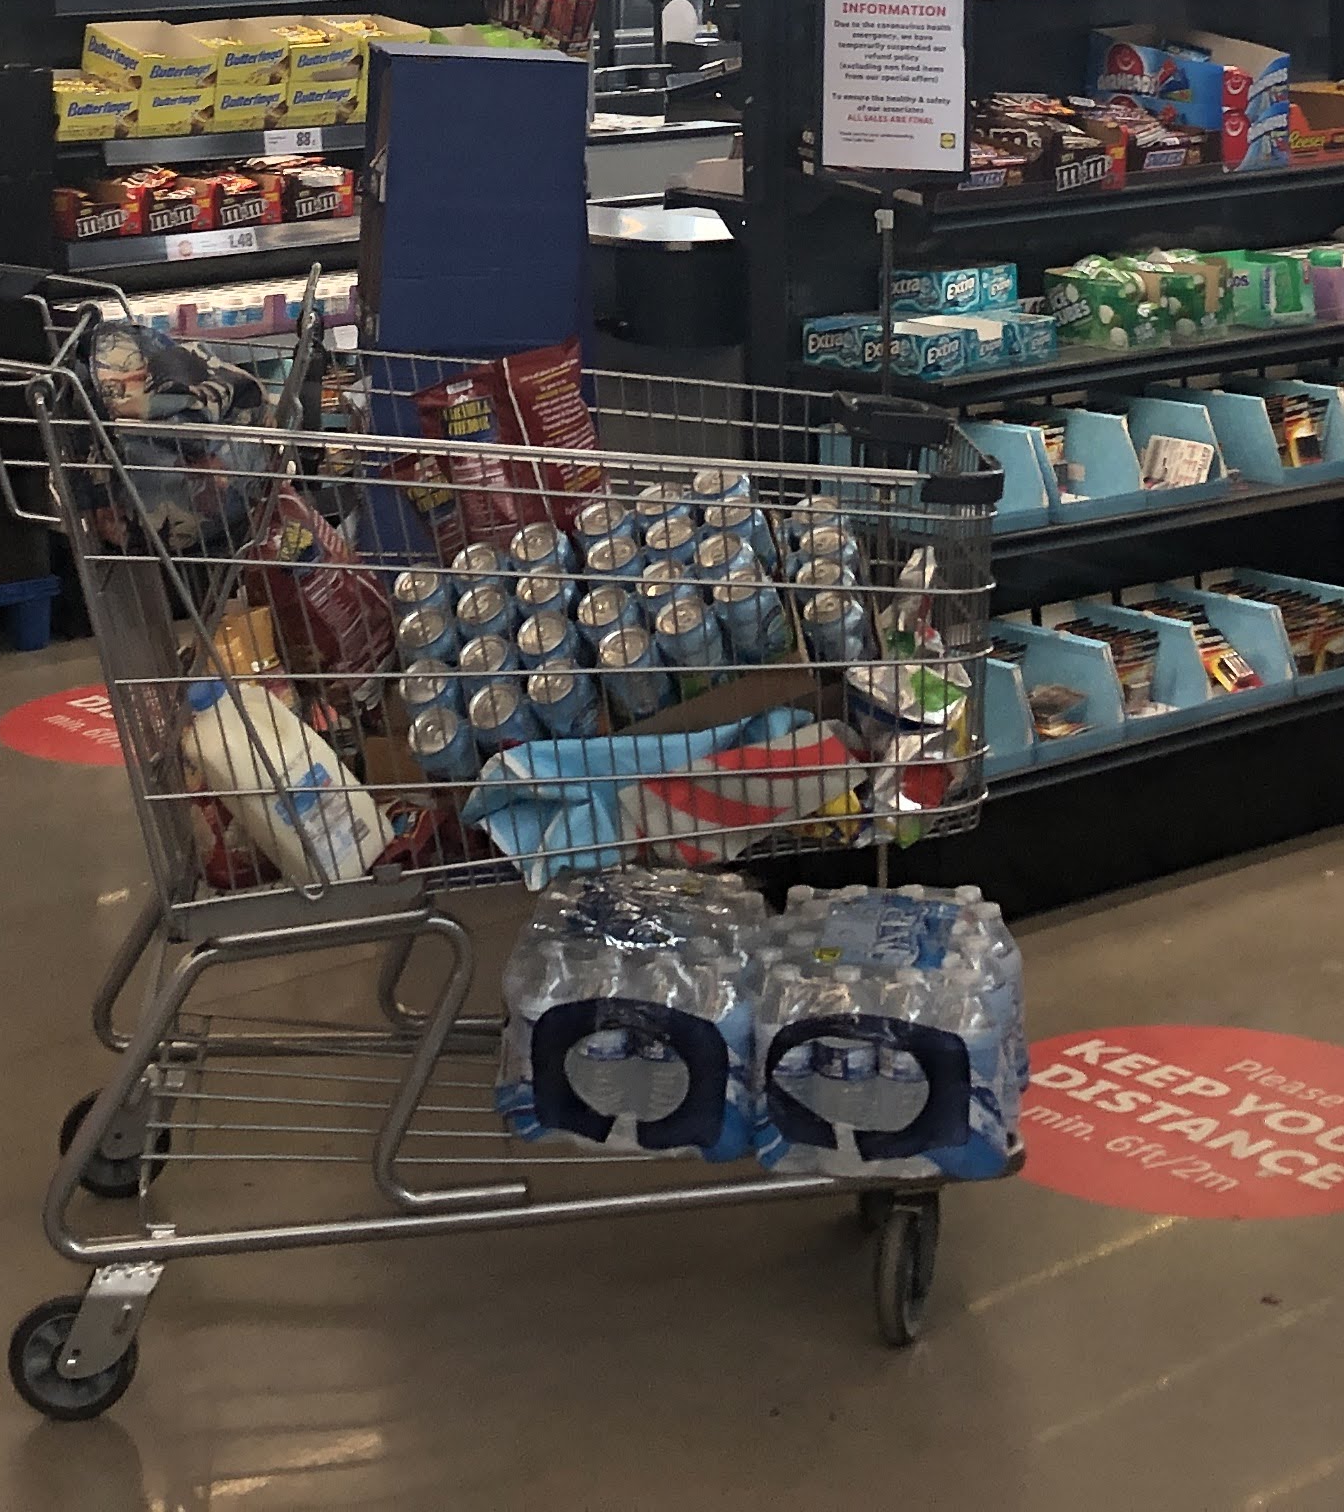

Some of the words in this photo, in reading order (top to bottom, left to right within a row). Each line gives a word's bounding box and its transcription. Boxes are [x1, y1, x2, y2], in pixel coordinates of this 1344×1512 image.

[843, 2, 946, 16] INFORMATION
[947, 278, 975, 301] Extra
[808, 332, 844, 354] Extra
[927, 339, 959, 364] Extra
[1063, 1039, 1231, 1098] KEEP
[1021, 1105, 1094, 1142] min.
[1107, 1135, 1240, 1193] 6ft/2m
